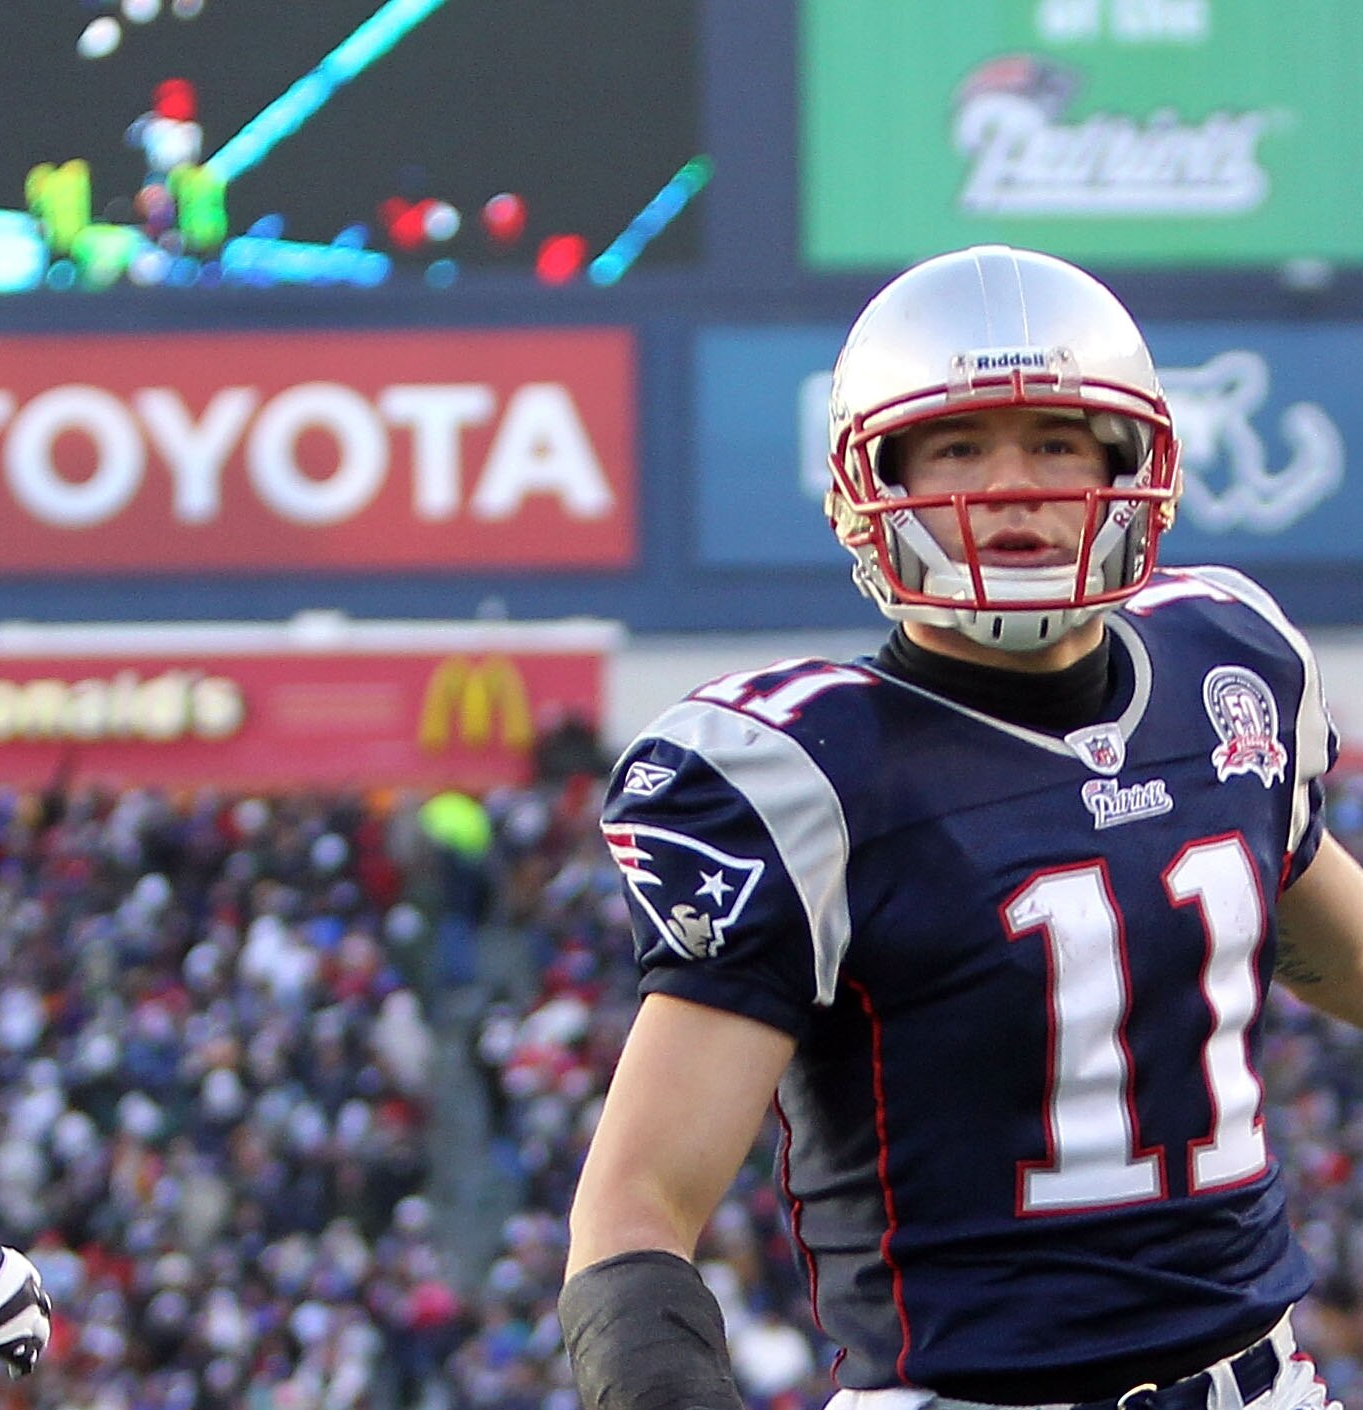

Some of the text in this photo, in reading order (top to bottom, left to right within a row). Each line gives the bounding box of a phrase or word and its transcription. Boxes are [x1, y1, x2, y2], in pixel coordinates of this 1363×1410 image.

[949, 94, 1271, 218] Patriots
[977, 353, 1045, 370] Riddell
[998, 830, 1270, 1219] 11
